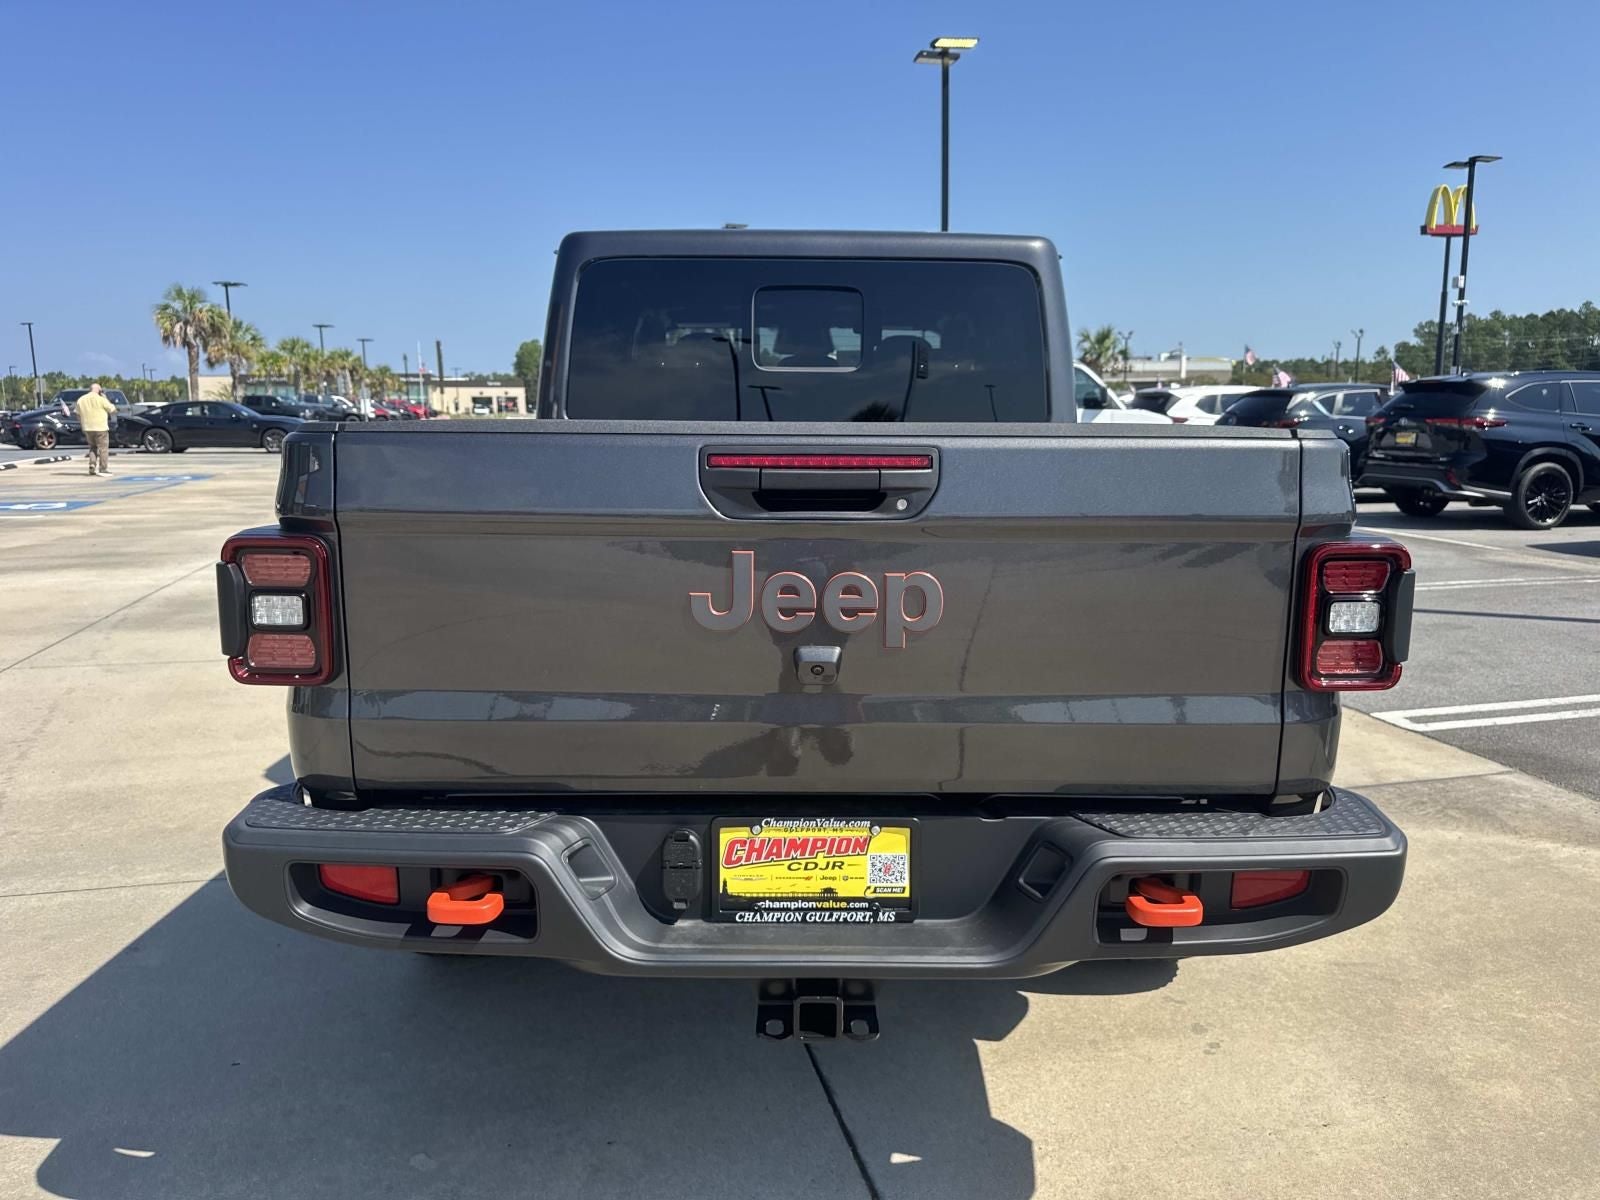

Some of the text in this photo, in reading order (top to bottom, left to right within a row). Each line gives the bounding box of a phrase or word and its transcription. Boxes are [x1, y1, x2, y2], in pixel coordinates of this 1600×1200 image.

[689, 550, 944, 649] Jeep
[761, 818, 871, 829] ChampionValue.com
[722, 835, 871, 867] CHAMPION
[787, 860, 845, 871] CDJR
[760, 900, 869, 909] championvalue.com
[735, 911, 896, 924] CHAMPION GULFPORT, MS
